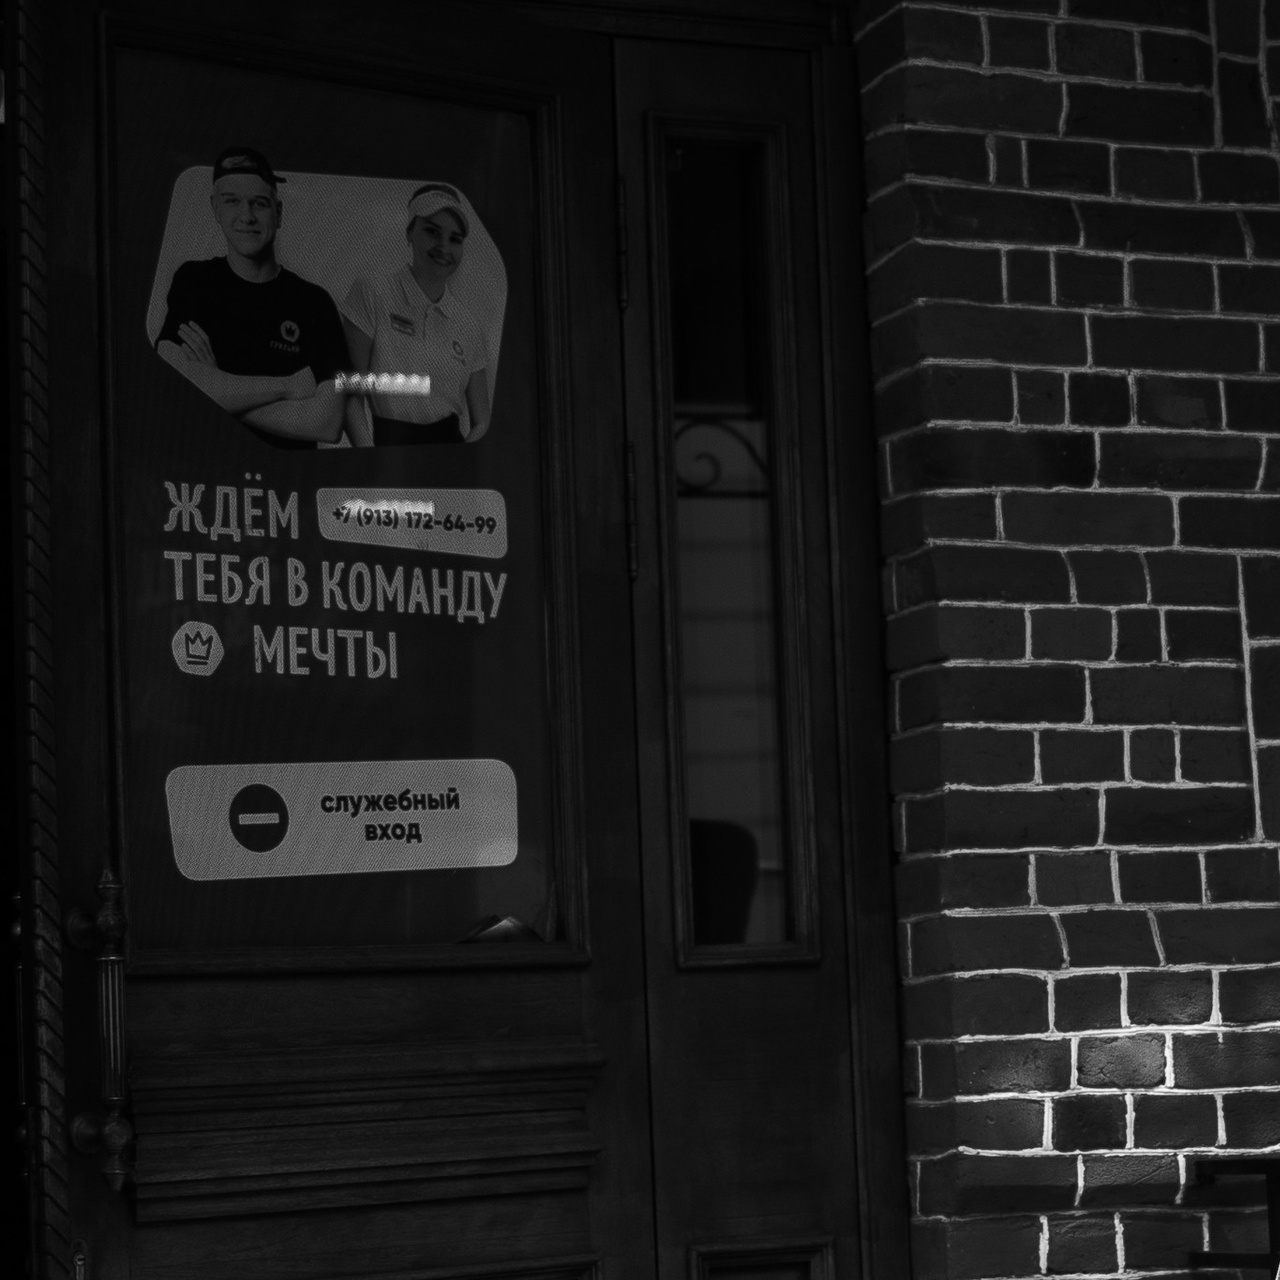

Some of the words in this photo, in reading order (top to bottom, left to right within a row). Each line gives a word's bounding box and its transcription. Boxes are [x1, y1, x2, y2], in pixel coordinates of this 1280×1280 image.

[164, 472, 299, 542] ЖДЁМ
[356, 507, 399, 529] (913)
[404, 511, 497, 535] 172-64-99
[164, 550, 271, 606] ТЕБЯ
[287, 557, 310, 608] В
[321, 560, 508, 625] КОМАНДУ
[253, 624, 398, 679] МЕЧТЫ
[320, 787, 461, 819] служебный
[364, 821, 423, 844] вход
